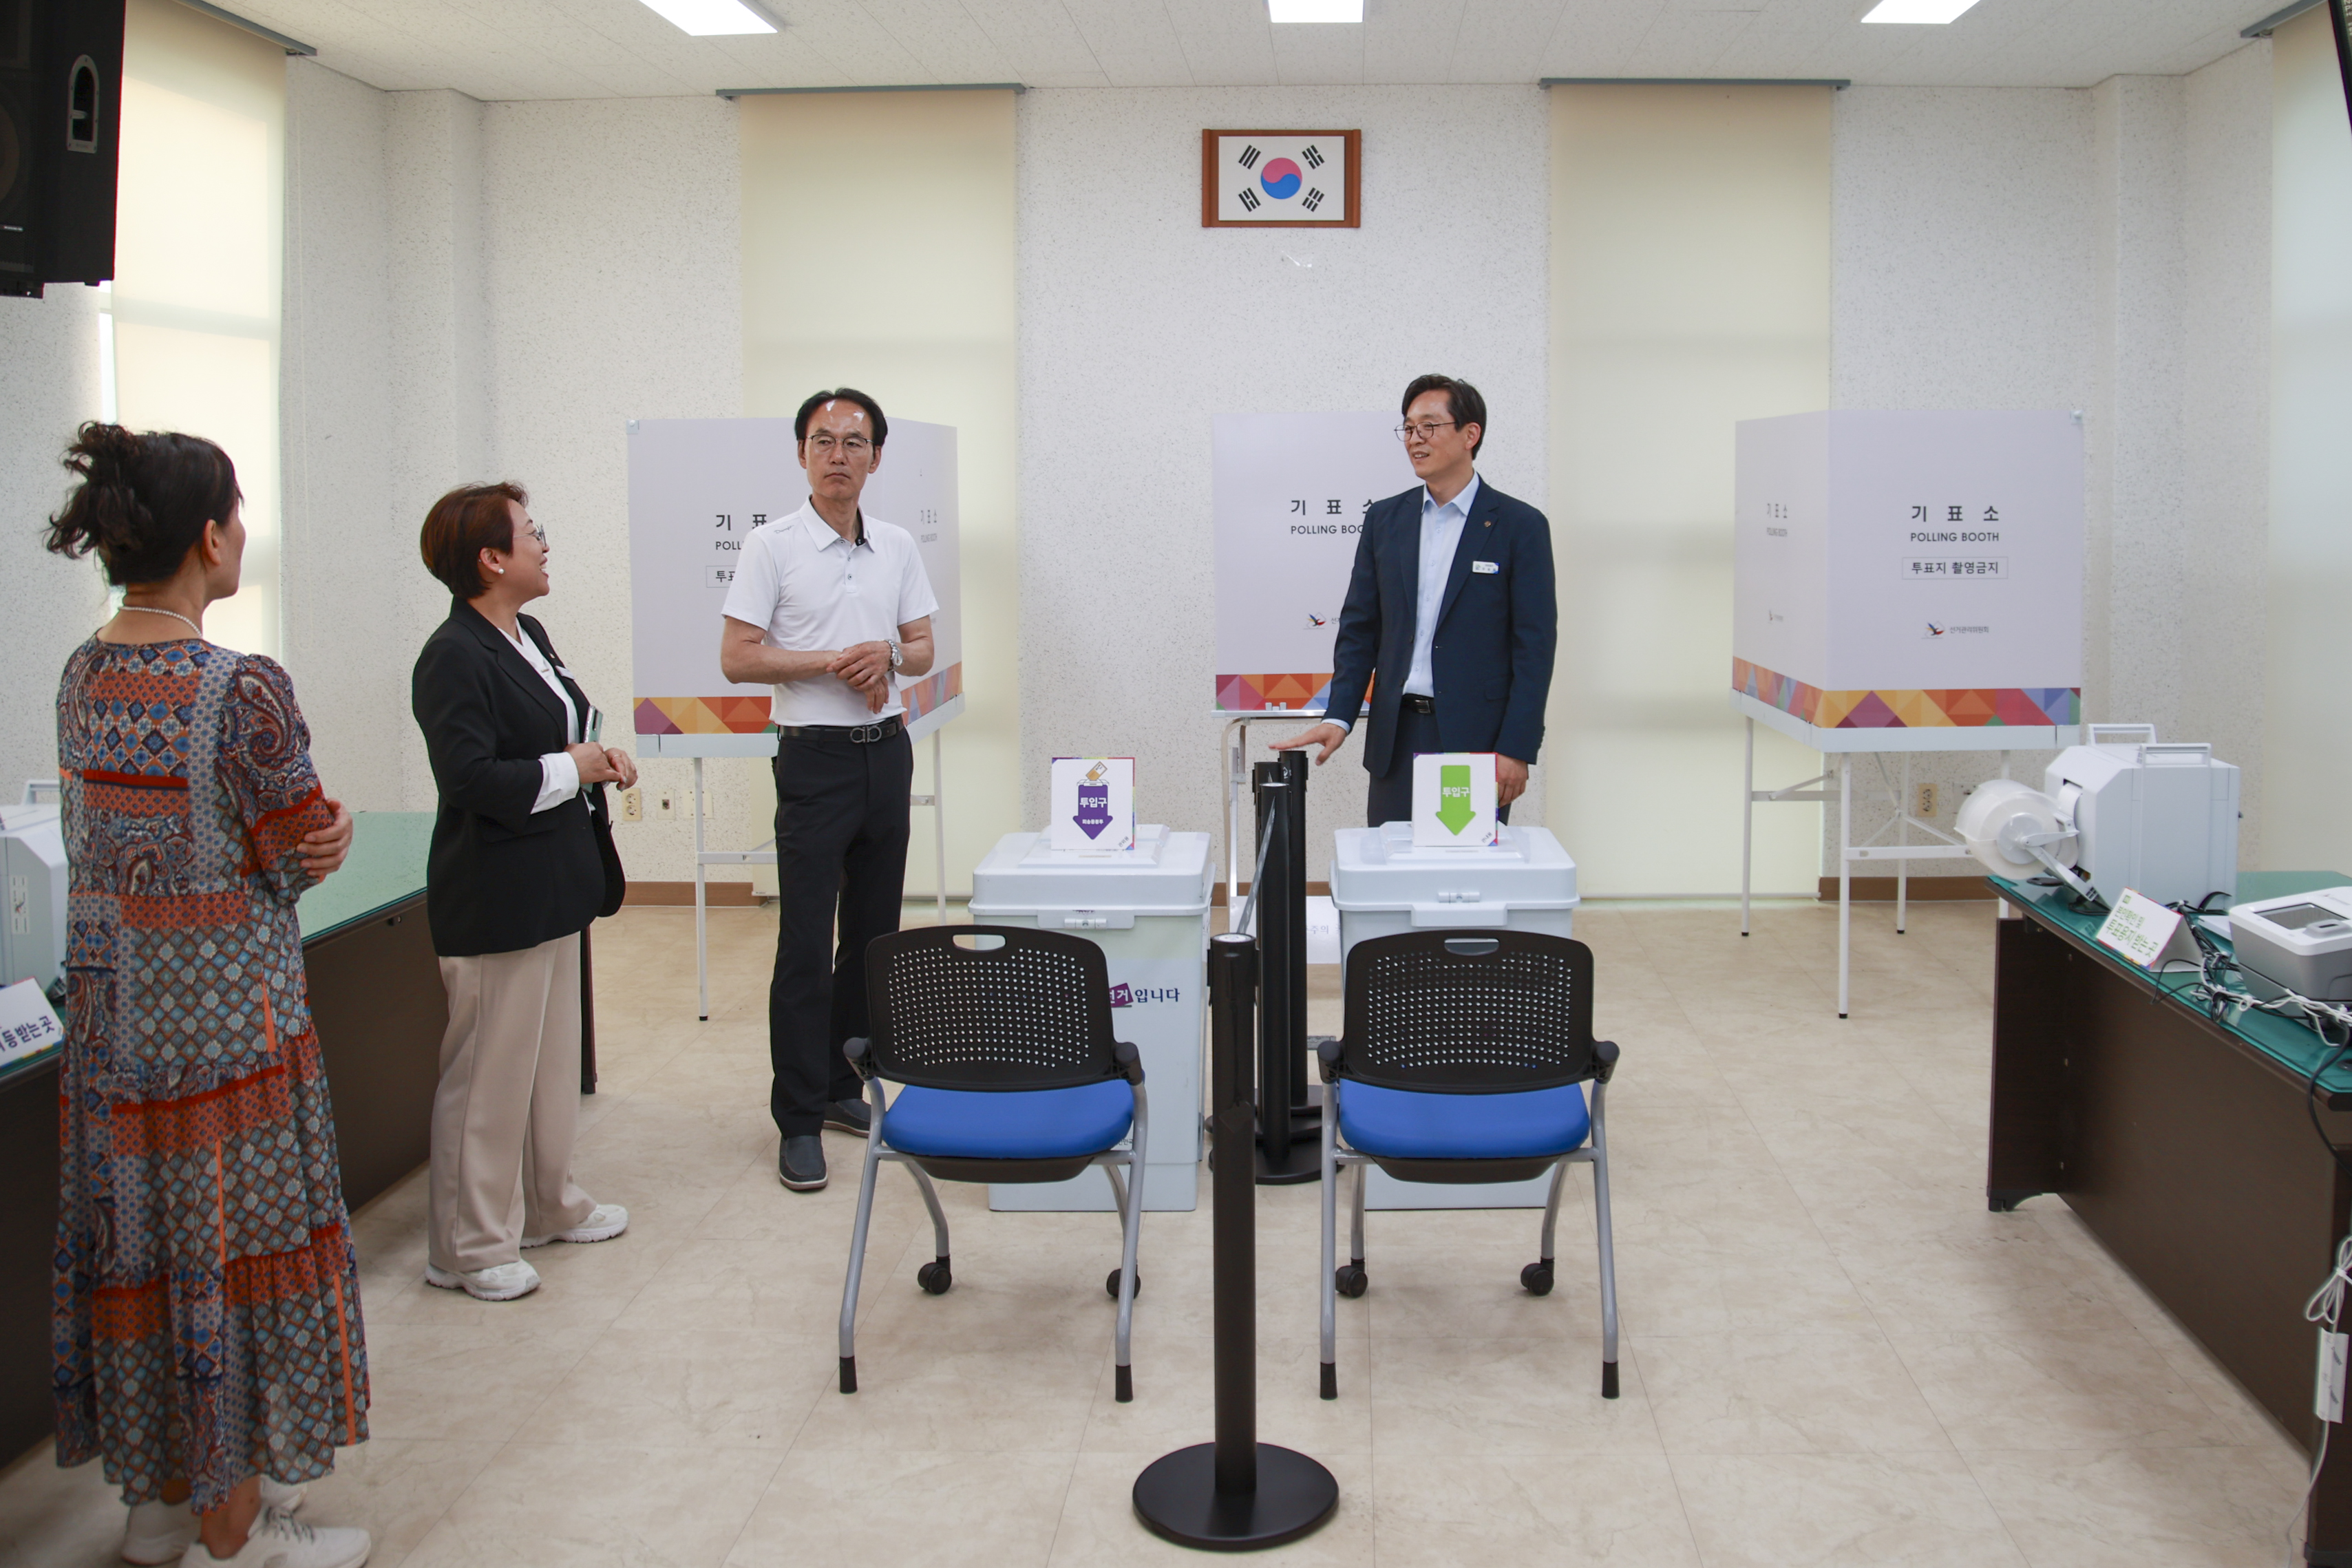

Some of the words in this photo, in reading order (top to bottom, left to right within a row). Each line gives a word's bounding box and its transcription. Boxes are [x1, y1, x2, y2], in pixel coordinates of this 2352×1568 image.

[1291, 525, 1337, 534] POLLING
[1342, 525, 1364, 534] BOO
[1911, 532, 1958, 542] POLLING
[1962, 532, 1999, 542] BOOTH
[716, 541, 742, 551] POLL
[1911, 562, 1946, 574] 투표지
[1951, 562, 1998, 574] 촬영금지
[716, 571, 735, 582] 투표
[1442, 787, 1470, 798] 투입구
[1079, 797, 1108, 808] 투입구
[1307, 925, 1328, 935] 주의
[2106, 919, 2137, 946] 투표용지
[2131, 935, 2149, 953] 받는
[2145, 942, 2159, 957] 곳
[14, 1023, 43, 1043] 받는
[39, 1015, 55, 1034] 곳
